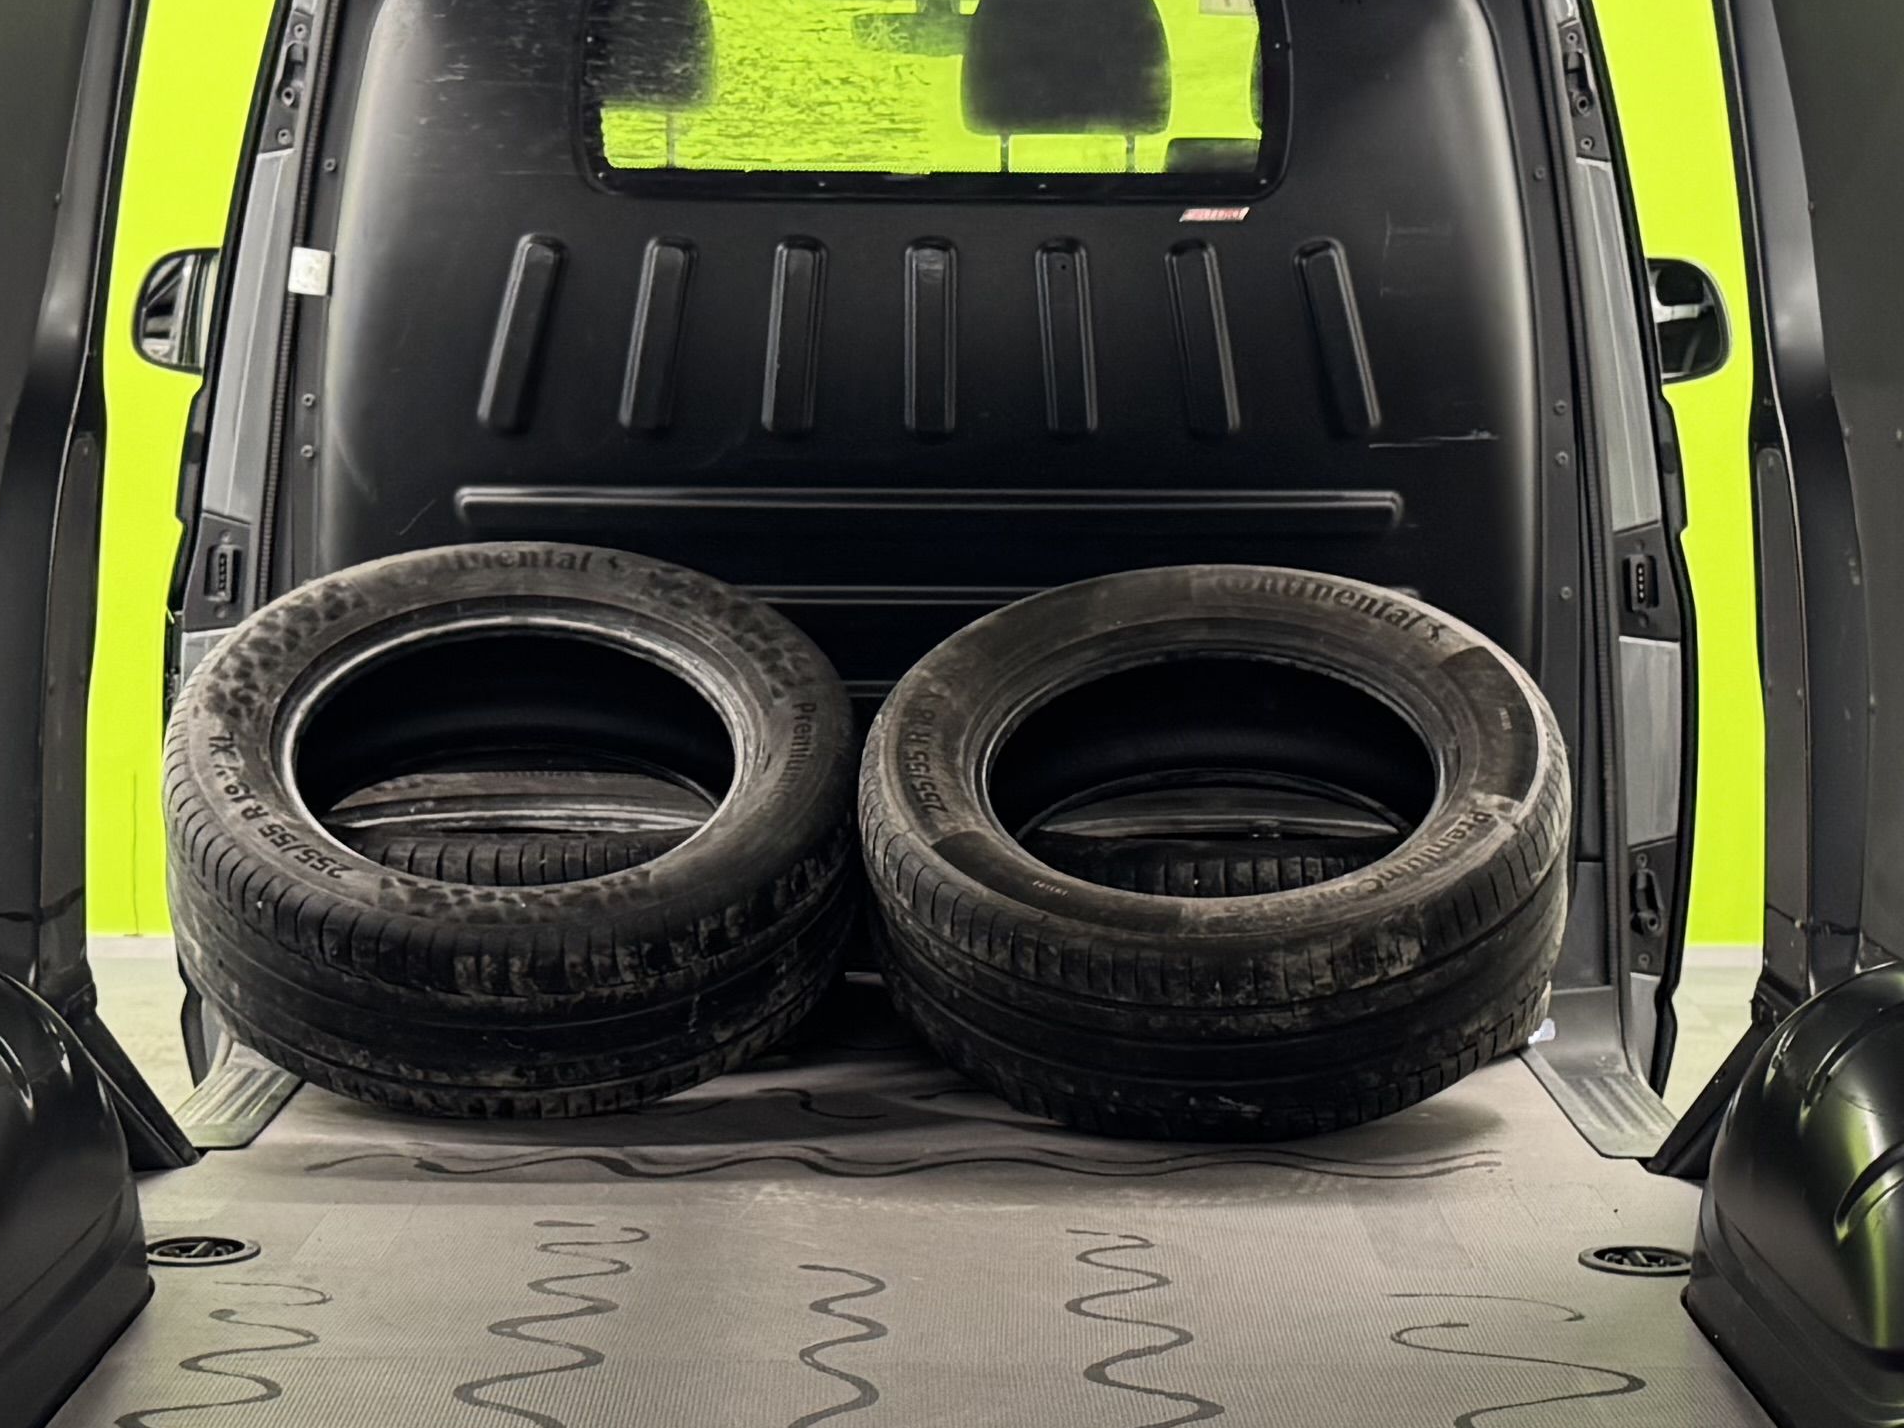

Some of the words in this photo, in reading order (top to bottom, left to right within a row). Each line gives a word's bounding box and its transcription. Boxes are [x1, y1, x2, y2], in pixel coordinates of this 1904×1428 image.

[209, 731, 236, 757] XL
[905, 750, 949, 813] 255/55
[241, 804, 269, 821] R
[258, 823, 353, 879] 255/55
